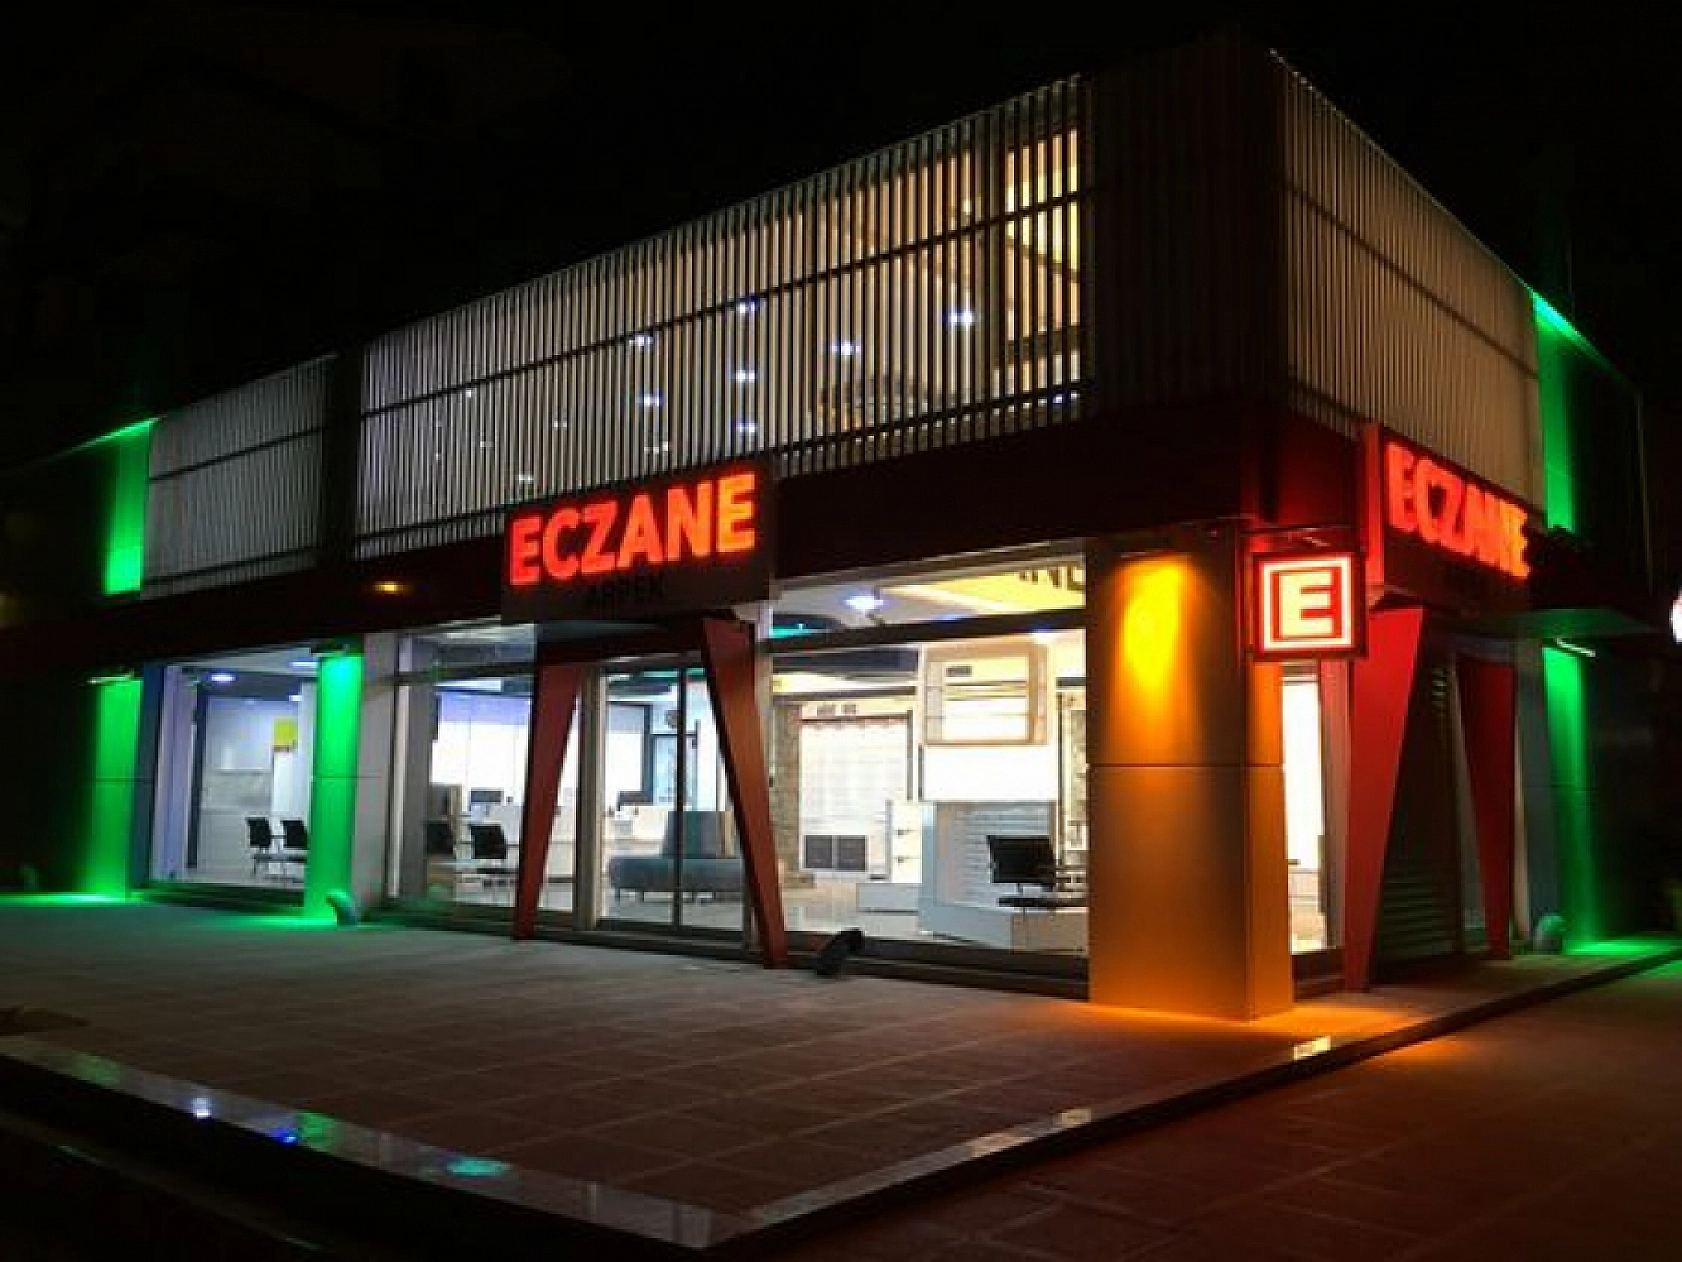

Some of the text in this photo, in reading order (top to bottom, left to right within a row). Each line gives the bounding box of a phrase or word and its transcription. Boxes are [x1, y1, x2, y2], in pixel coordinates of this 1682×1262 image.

[509, 473, 756, 587] ECZANE
[1388, 441, 1530, 578] ECZANE
[1279, 571, 1333, 637] E
